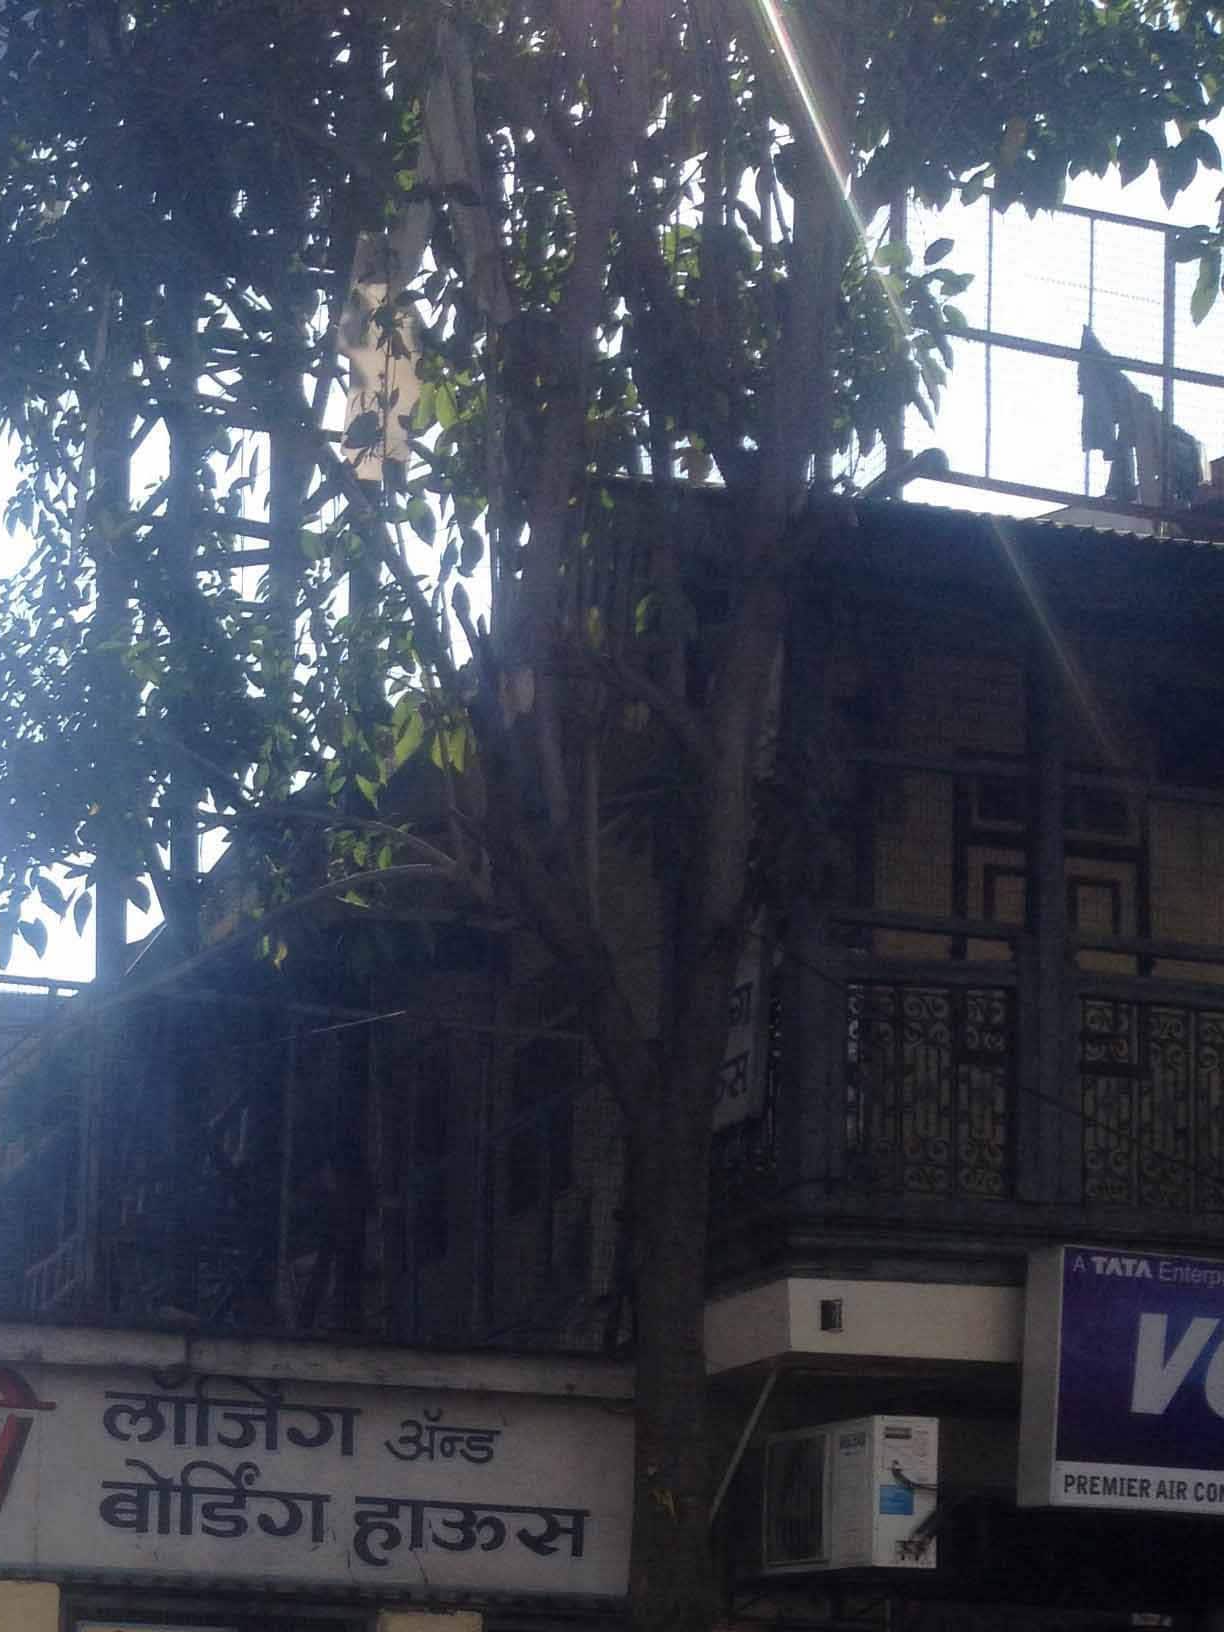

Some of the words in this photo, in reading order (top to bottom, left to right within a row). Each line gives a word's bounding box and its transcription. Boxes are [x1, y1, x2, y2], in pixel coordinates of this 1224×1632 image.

[1072, 1255, 1087, 1272] A
[1091, 1256, 1153, 1278] TATA
[1159, 1261, 1224, 1288] Enterp
[1063, 1474, 1151, 1498] PREMIER
[1156, 1480, 1188, 1500] AIR
[352, 1495, 591, 1567] हाऊस
